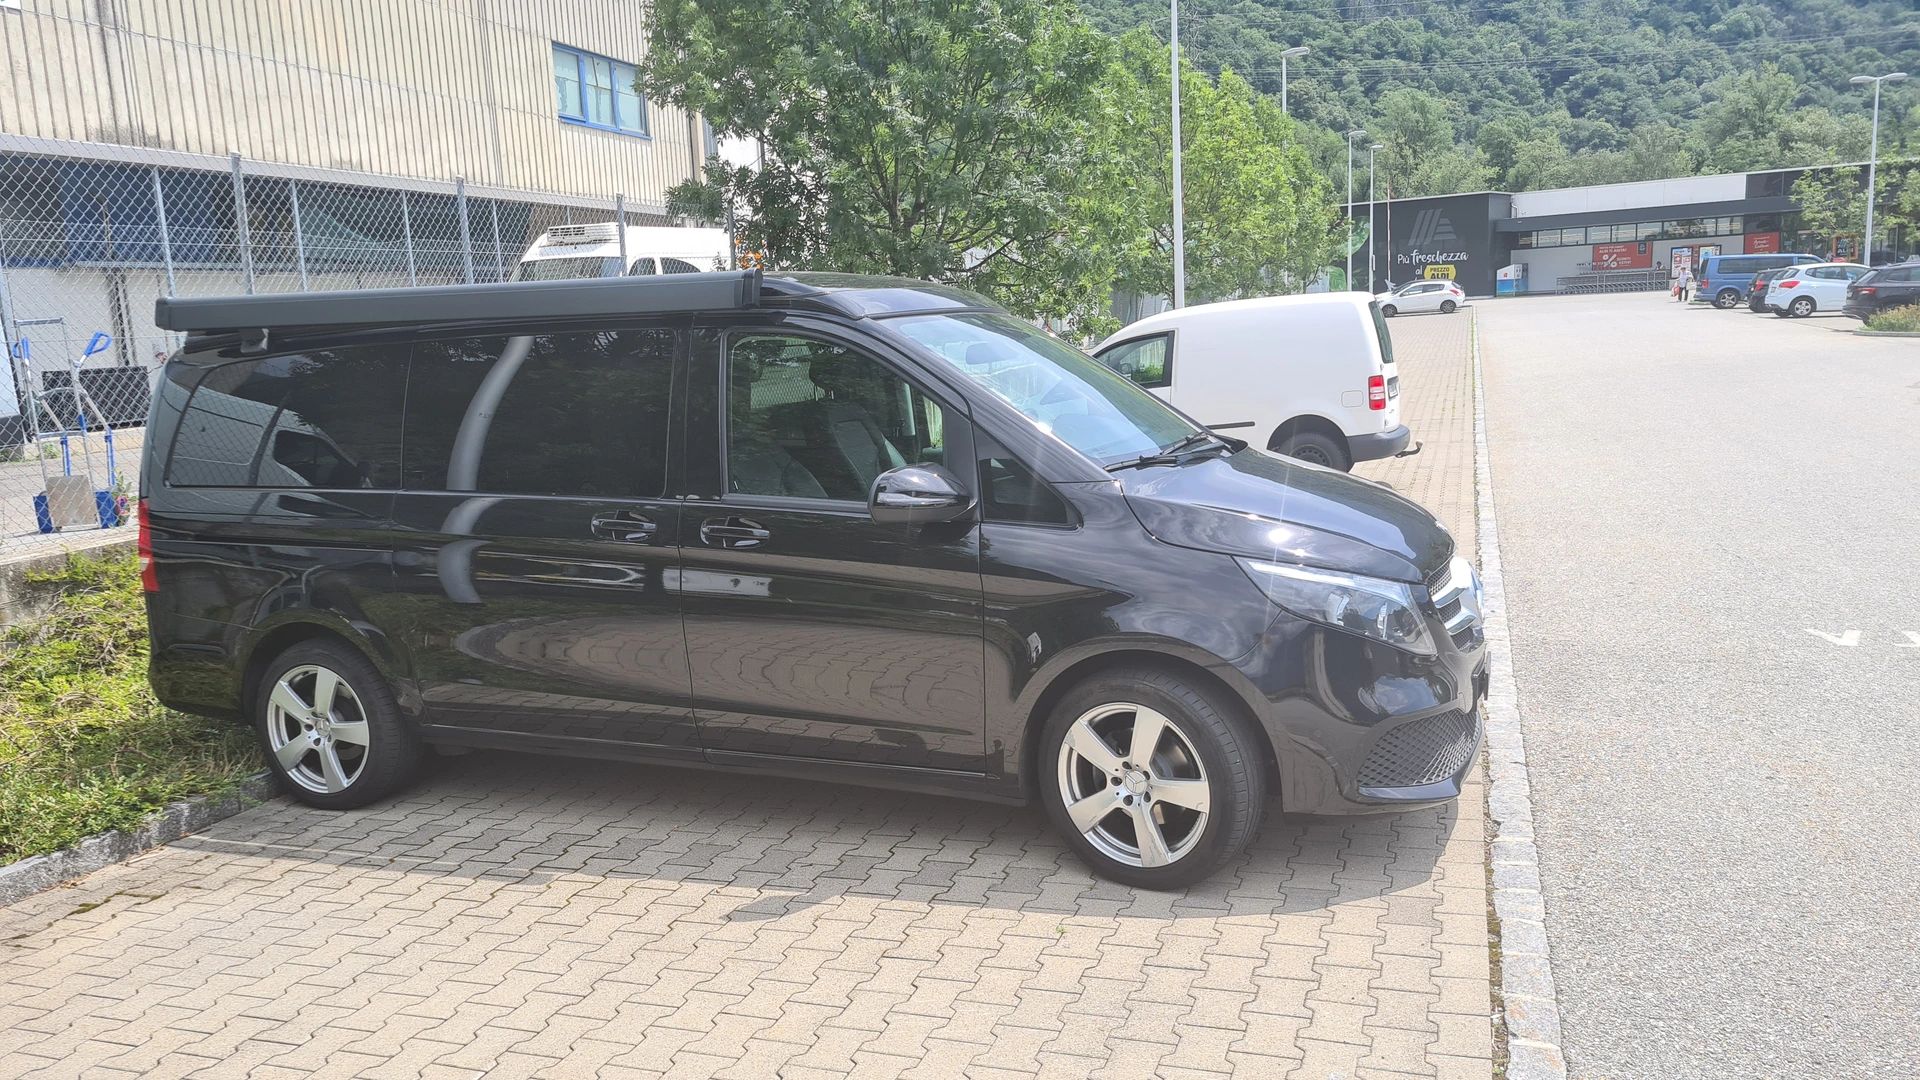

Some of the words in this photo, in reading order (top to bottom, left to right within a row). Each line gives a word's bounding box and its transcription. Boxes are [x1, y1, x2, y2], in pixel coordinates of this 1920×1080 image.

[1397, 254, 1410, 264] Più
[1410, 249, 1469, 265] freschezza
[1415, 265, 1423, 275] al
